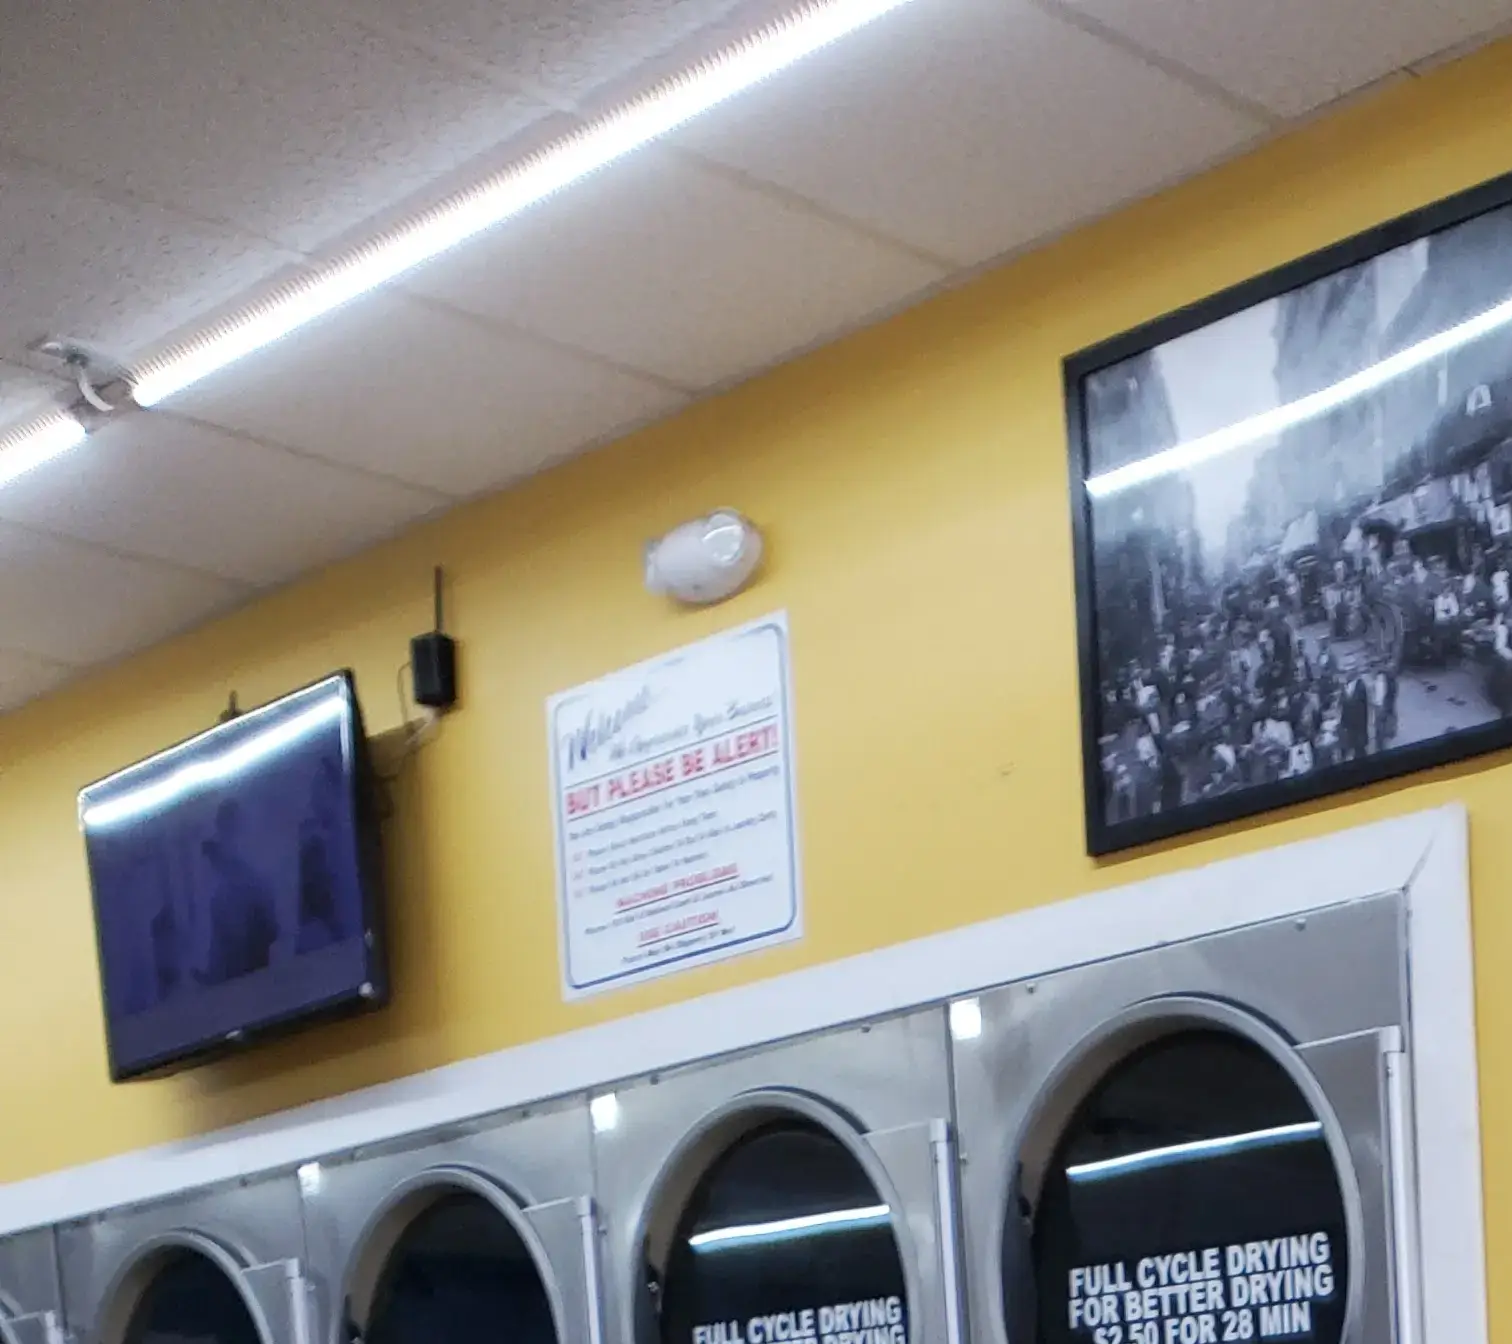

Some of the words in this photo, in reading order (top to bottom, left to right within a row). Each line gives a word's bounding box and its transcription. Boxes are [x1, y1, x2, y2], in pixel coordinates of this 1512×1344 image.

[565, 784, 600, 816] BUT
[607, 758, 675, 798] PLEASE
[679, 749, 705, 777] BE
[712, 723, 779, 764] ALERT!
[1069, 1261, 1132, 1298] FULL
[1137, 1248, 1219, 1289] CYCLE
[1226, 1231, 1330, 1276] DRYING
[1069, 1295, 1119, 1329] FOR
[1124, 1280, 1226, 1322] BETTER
[1231, 1264, 1334, 1307] DRYING
[748, 1309, 816, 1344] CYCLE
[818, 1296, 902, 1334] DRYING
[1222, 1310, 1253, 1341] 28
[1260, 1301, 1311, 1337] MIN
